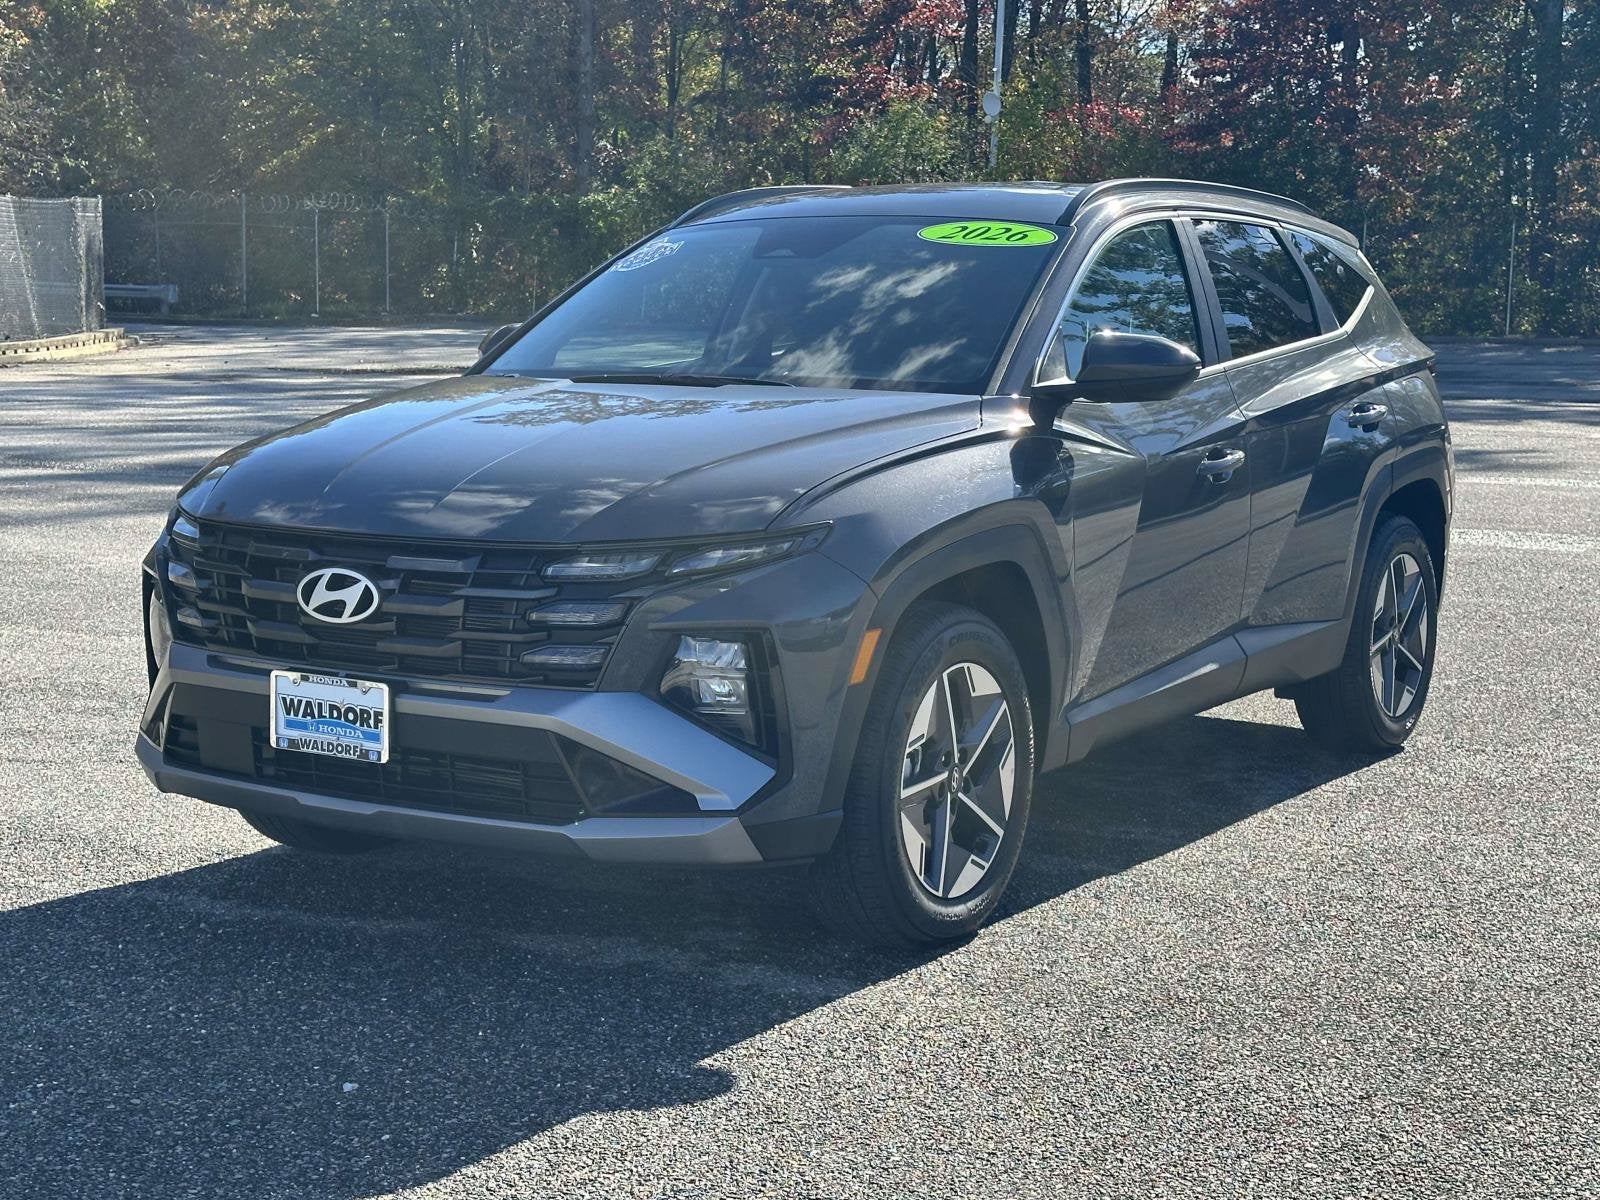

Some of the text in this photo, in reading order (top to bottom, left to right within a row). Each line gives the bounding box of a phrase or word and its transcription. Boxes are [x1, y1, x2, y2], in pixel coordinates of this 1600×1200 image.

[938, 225, 1039, 242] 2026
[308, 674, 350, 688] HONDA
[279, 695, 384, 731] WALDORF
[318, 723, 364, 739] HONDA
[299, 737, 360, 759] WALDORF
